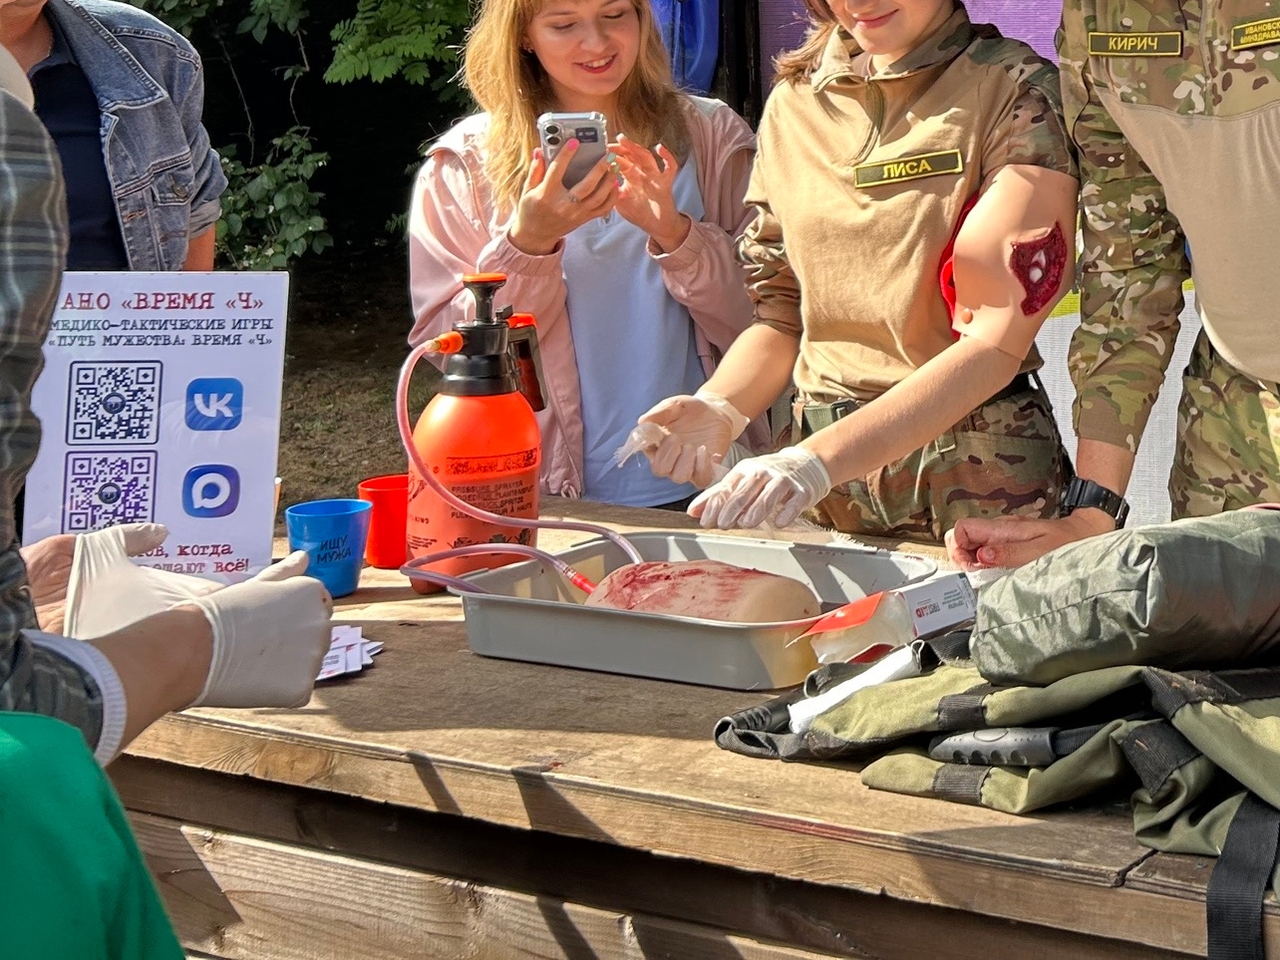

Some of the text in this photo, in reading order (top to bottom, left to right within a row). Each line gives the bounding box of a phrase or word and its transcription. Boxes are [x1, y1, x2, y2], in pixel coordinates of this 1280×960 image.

[1108, 36, 1158, 51] КИРИЧ
[882, 159, 932, 179] ЛИСА
[60, 292, 264, 310] АНО «ВРЕМЯ «Ч»
[231, 318, 274, 331] ИГРЫ
[48, 334, 273, 347] «ПУТЬ МУЖЕСТВА: ВРЕМЯ «Ч»
[319, 534, 348, 551] ИЩУ
[177, 544, 234, 558] когда
[316, 547, 352, 564] МУЖА
[213, 558, 250, 573] всё!
